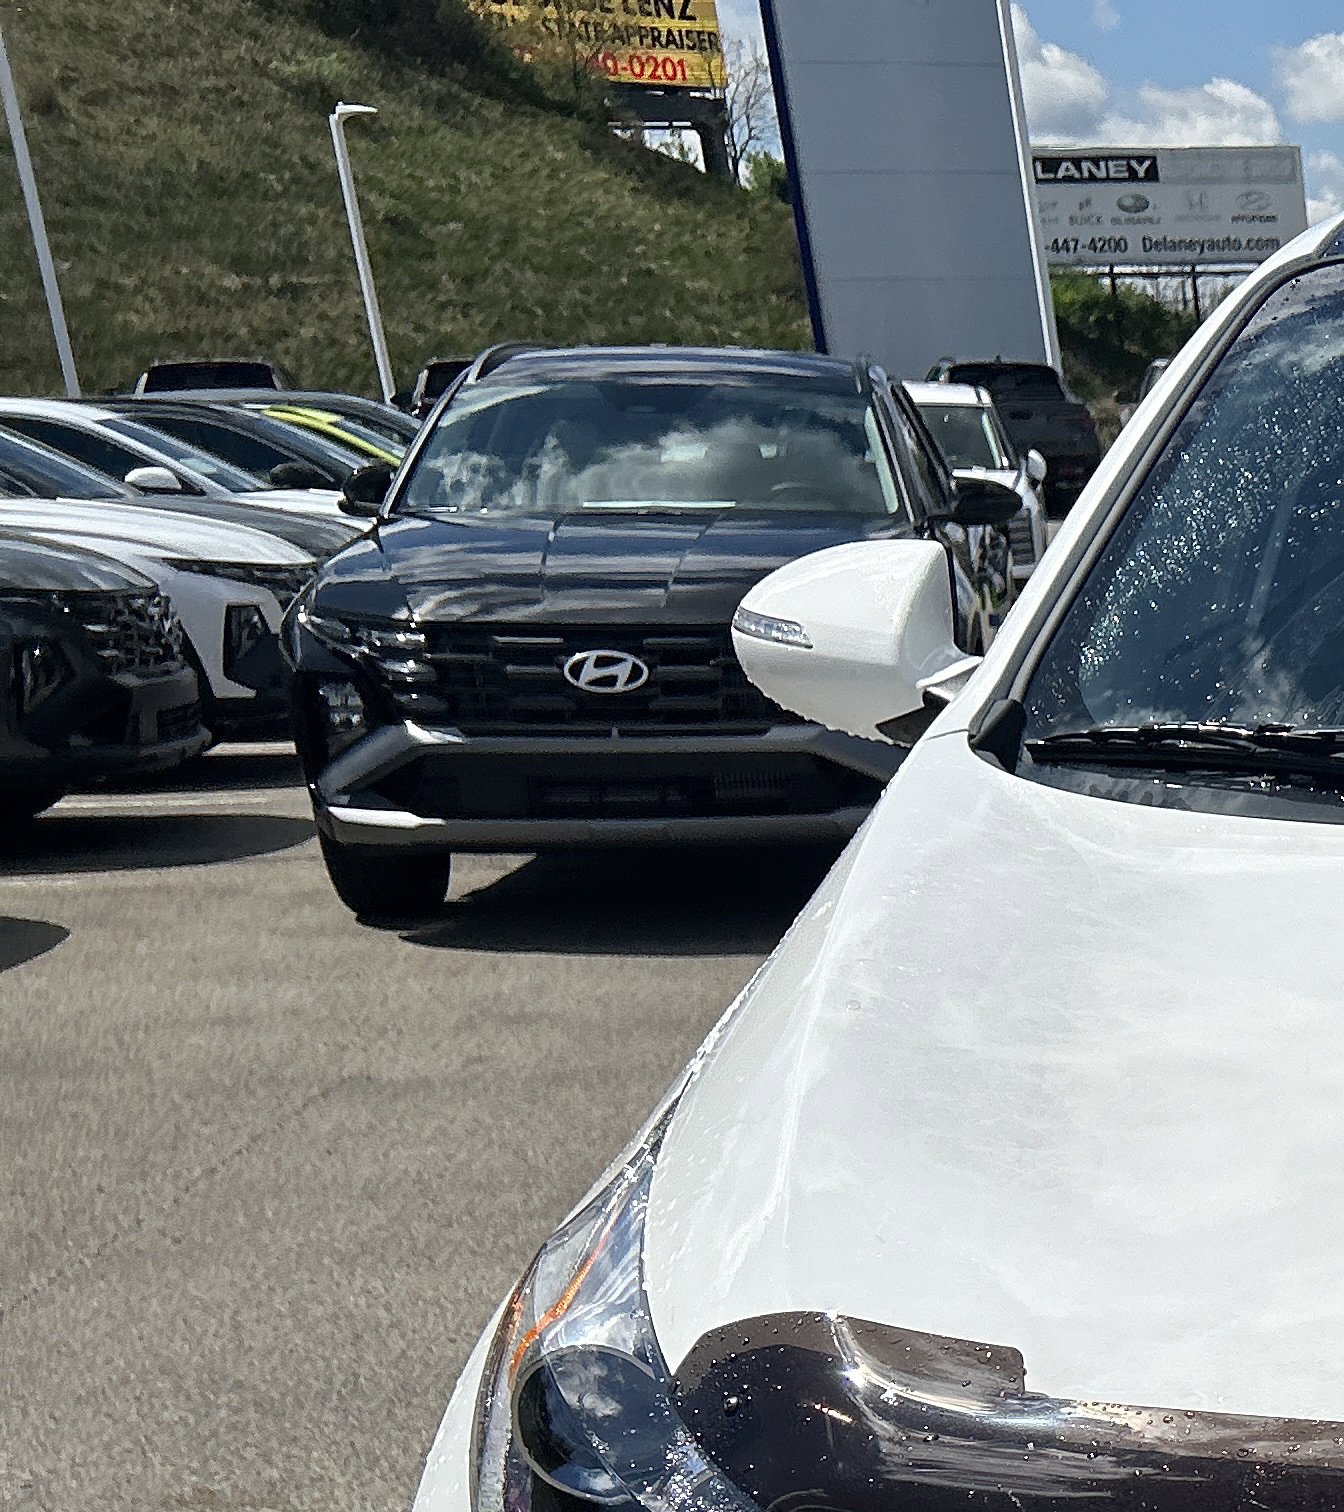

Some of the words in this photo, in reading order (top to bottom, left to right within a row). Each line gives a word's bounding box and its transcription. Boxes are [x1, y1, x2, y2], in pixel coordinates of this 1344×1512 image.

[590, 51, 688, 81] 0-0201
[1034, 158, 1153, 179] LANEY
[1142, 234, 1281, 255] Delaneyauto.com
